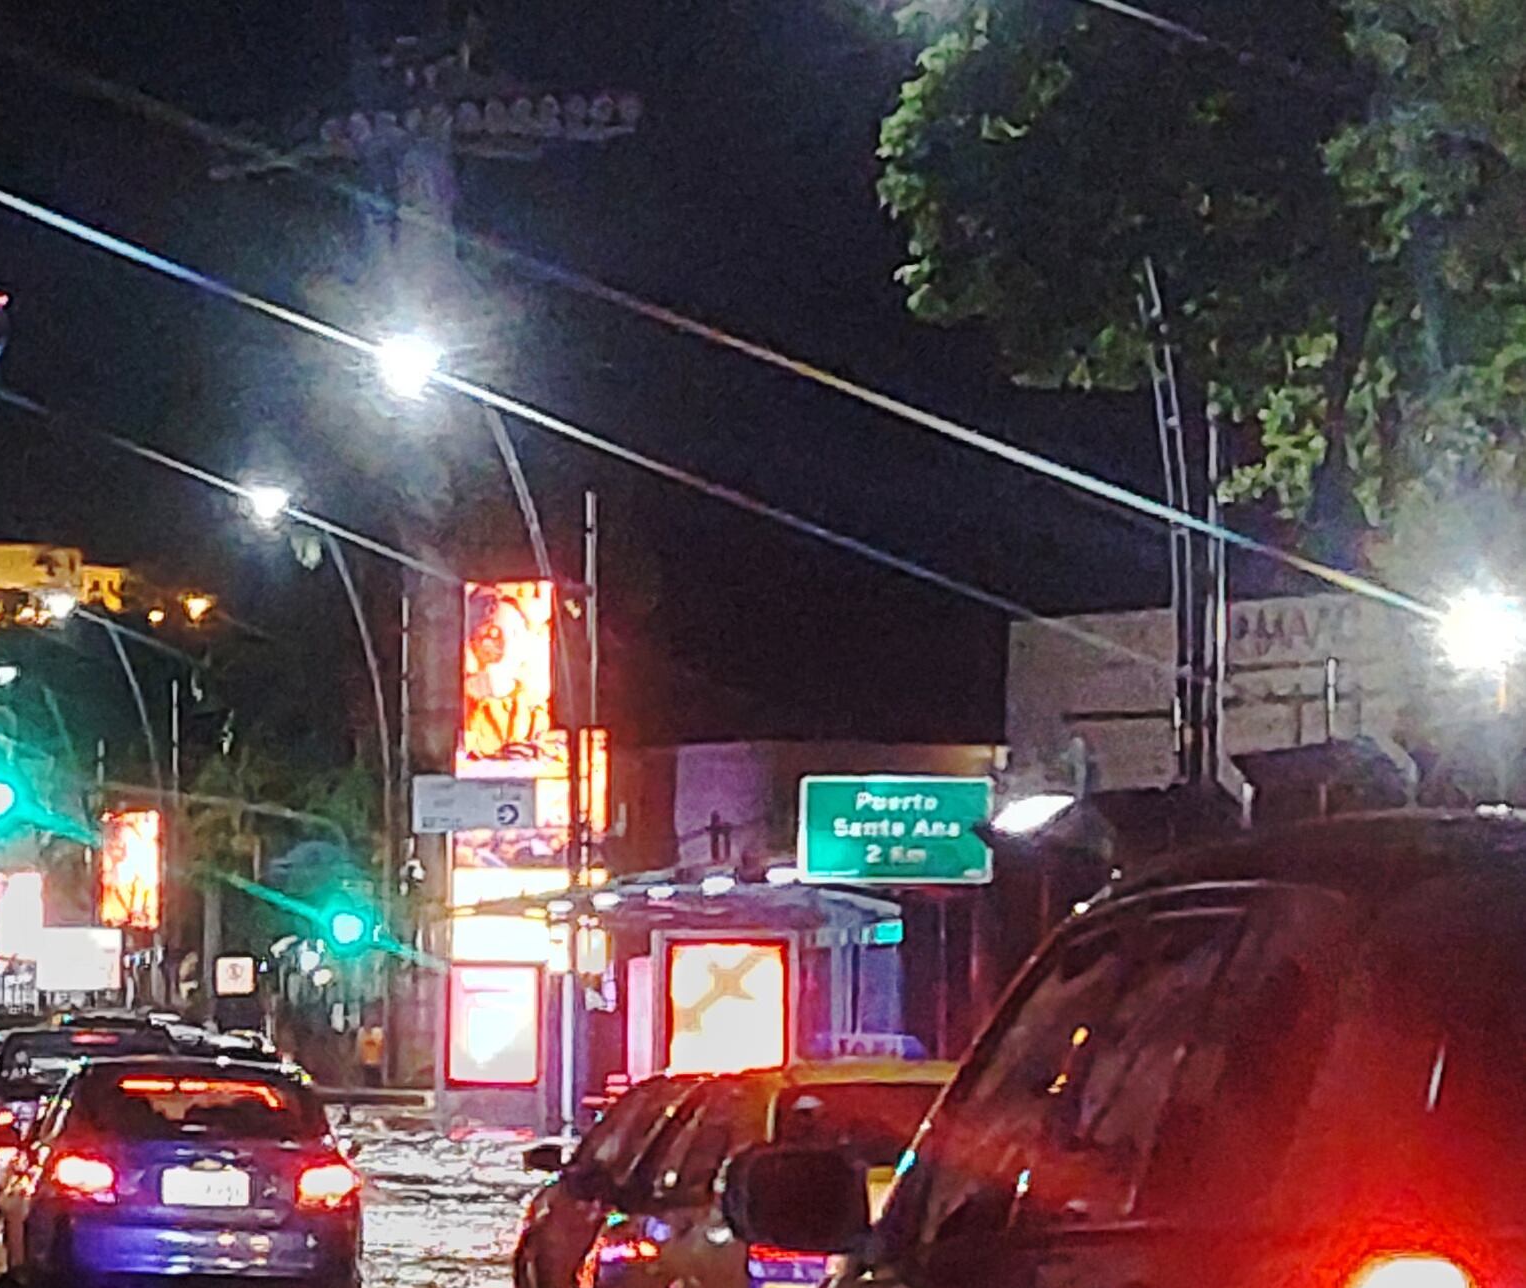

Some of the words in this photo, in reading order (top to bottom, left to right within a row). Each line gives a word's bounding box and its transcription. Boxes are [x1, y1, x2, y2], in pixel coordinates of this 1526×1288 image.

[855, 791, 939, 812] Puerto
[833, 817, 906, 838] Santa
[911, 818, 961, 838] Ana
[865, 844, 882, 864] 2
